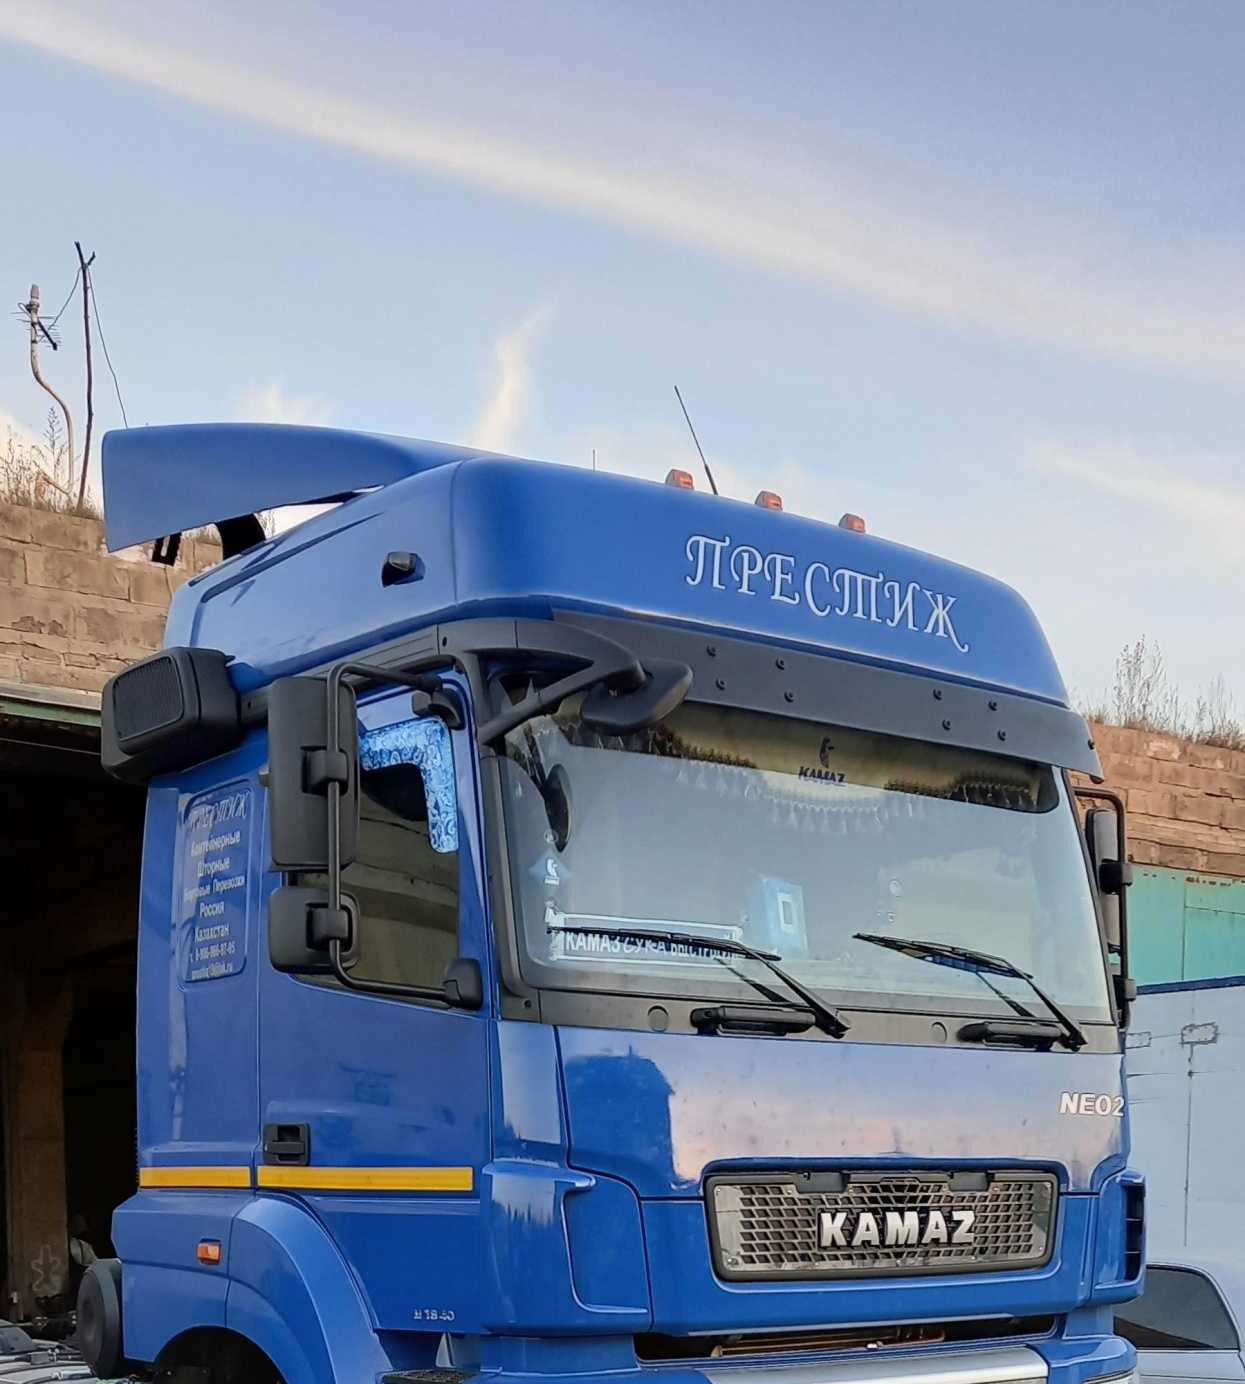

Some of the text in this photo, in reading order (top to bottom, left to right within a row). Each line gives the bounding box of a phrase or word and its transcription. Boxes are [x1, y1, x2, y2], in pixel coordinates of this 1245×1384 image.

[686, 535, 969, 653] ПРЕСТИЖ
[200, 901, 225, 918] Россия
[1059, 1091, 1125, 1117] NEO2
[819, 1209, 976, 1247] KAMAZ
